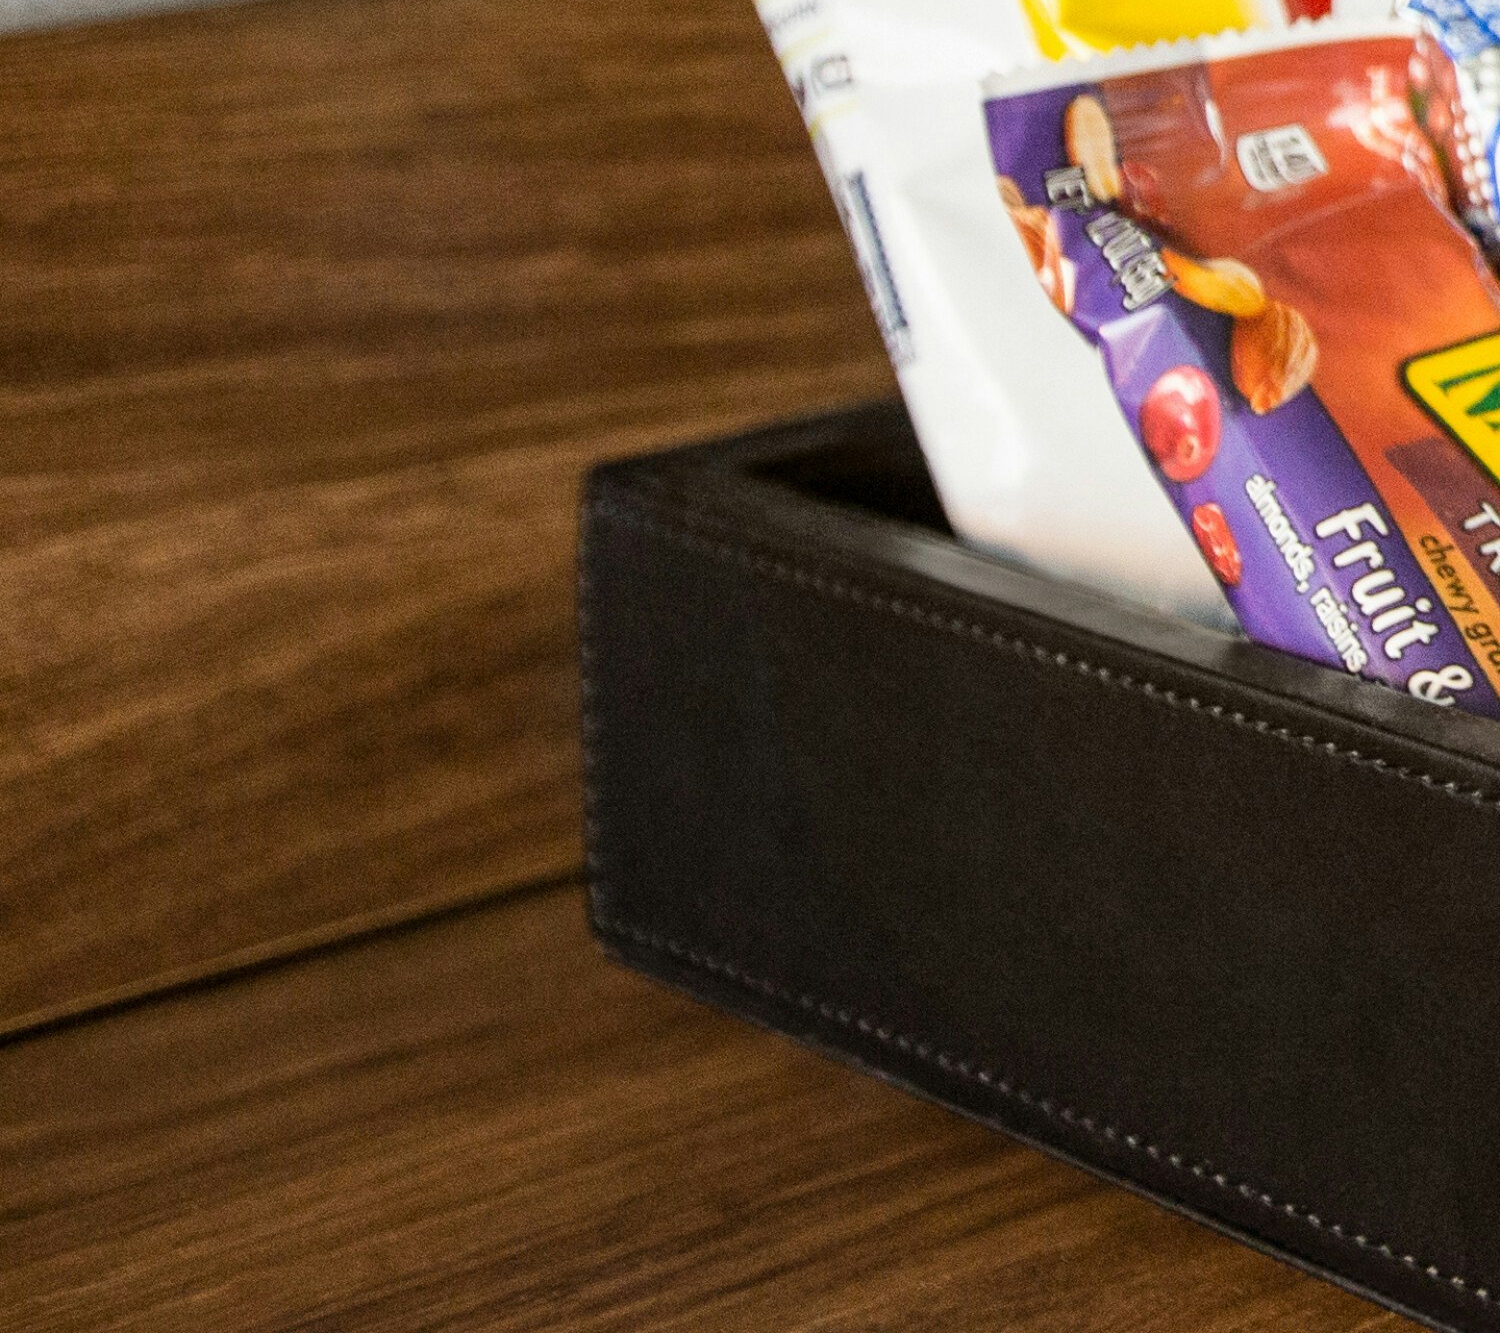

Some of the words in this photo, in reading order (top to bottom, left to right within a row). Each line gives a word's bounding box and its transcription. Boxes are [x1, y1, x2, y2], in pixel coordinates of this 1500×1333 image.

[1314, 501, 1440, 661] Fruit
[1406, 663, 1475, 709] &
[1417, 531, 1479, 619] chewy
